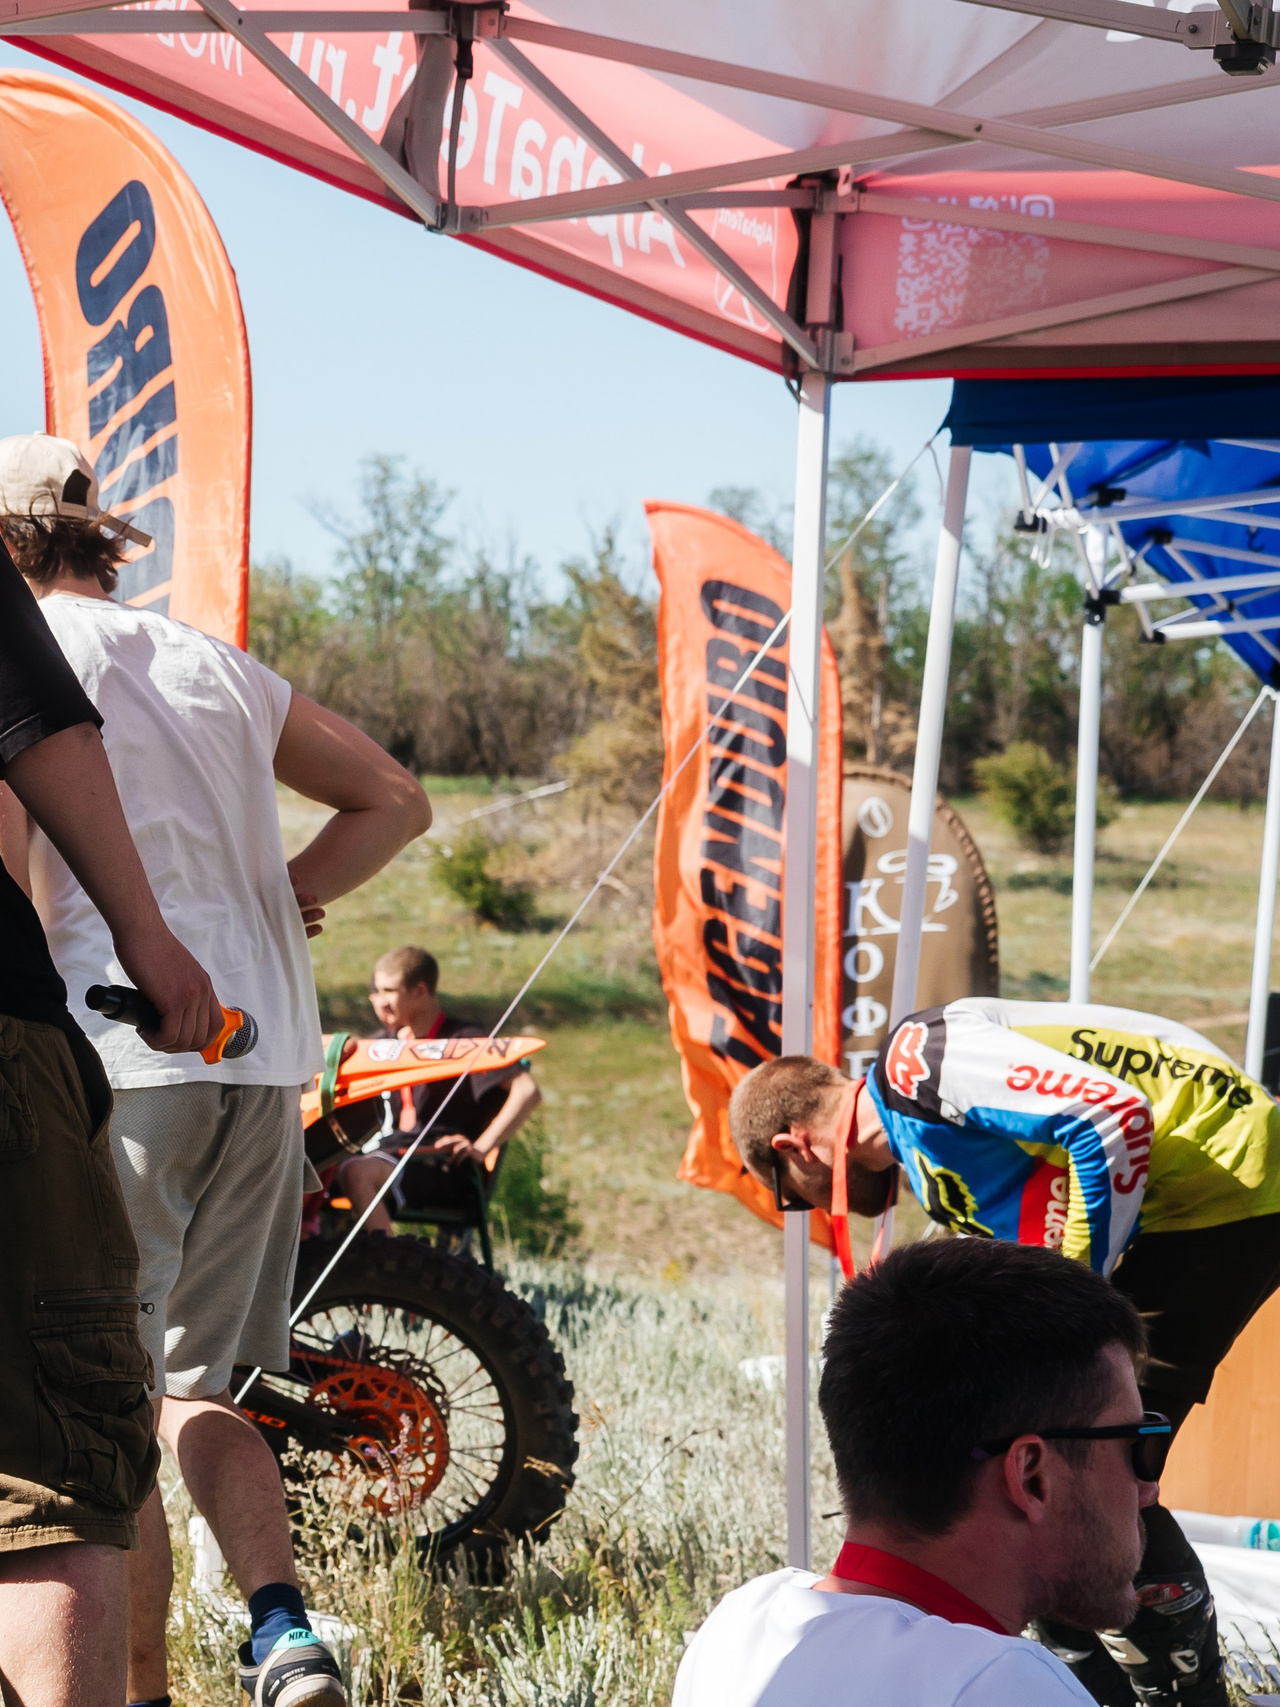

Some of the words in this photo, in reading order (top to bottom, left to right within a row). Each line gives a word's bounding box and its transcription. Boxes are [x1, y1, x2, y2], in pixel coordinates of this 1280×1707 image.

[1068, 1029, 1254, 1110] Supreme
[1043, 1176, 1070, 1248] eme
[288, 1631, 310, 1642] NIKE
